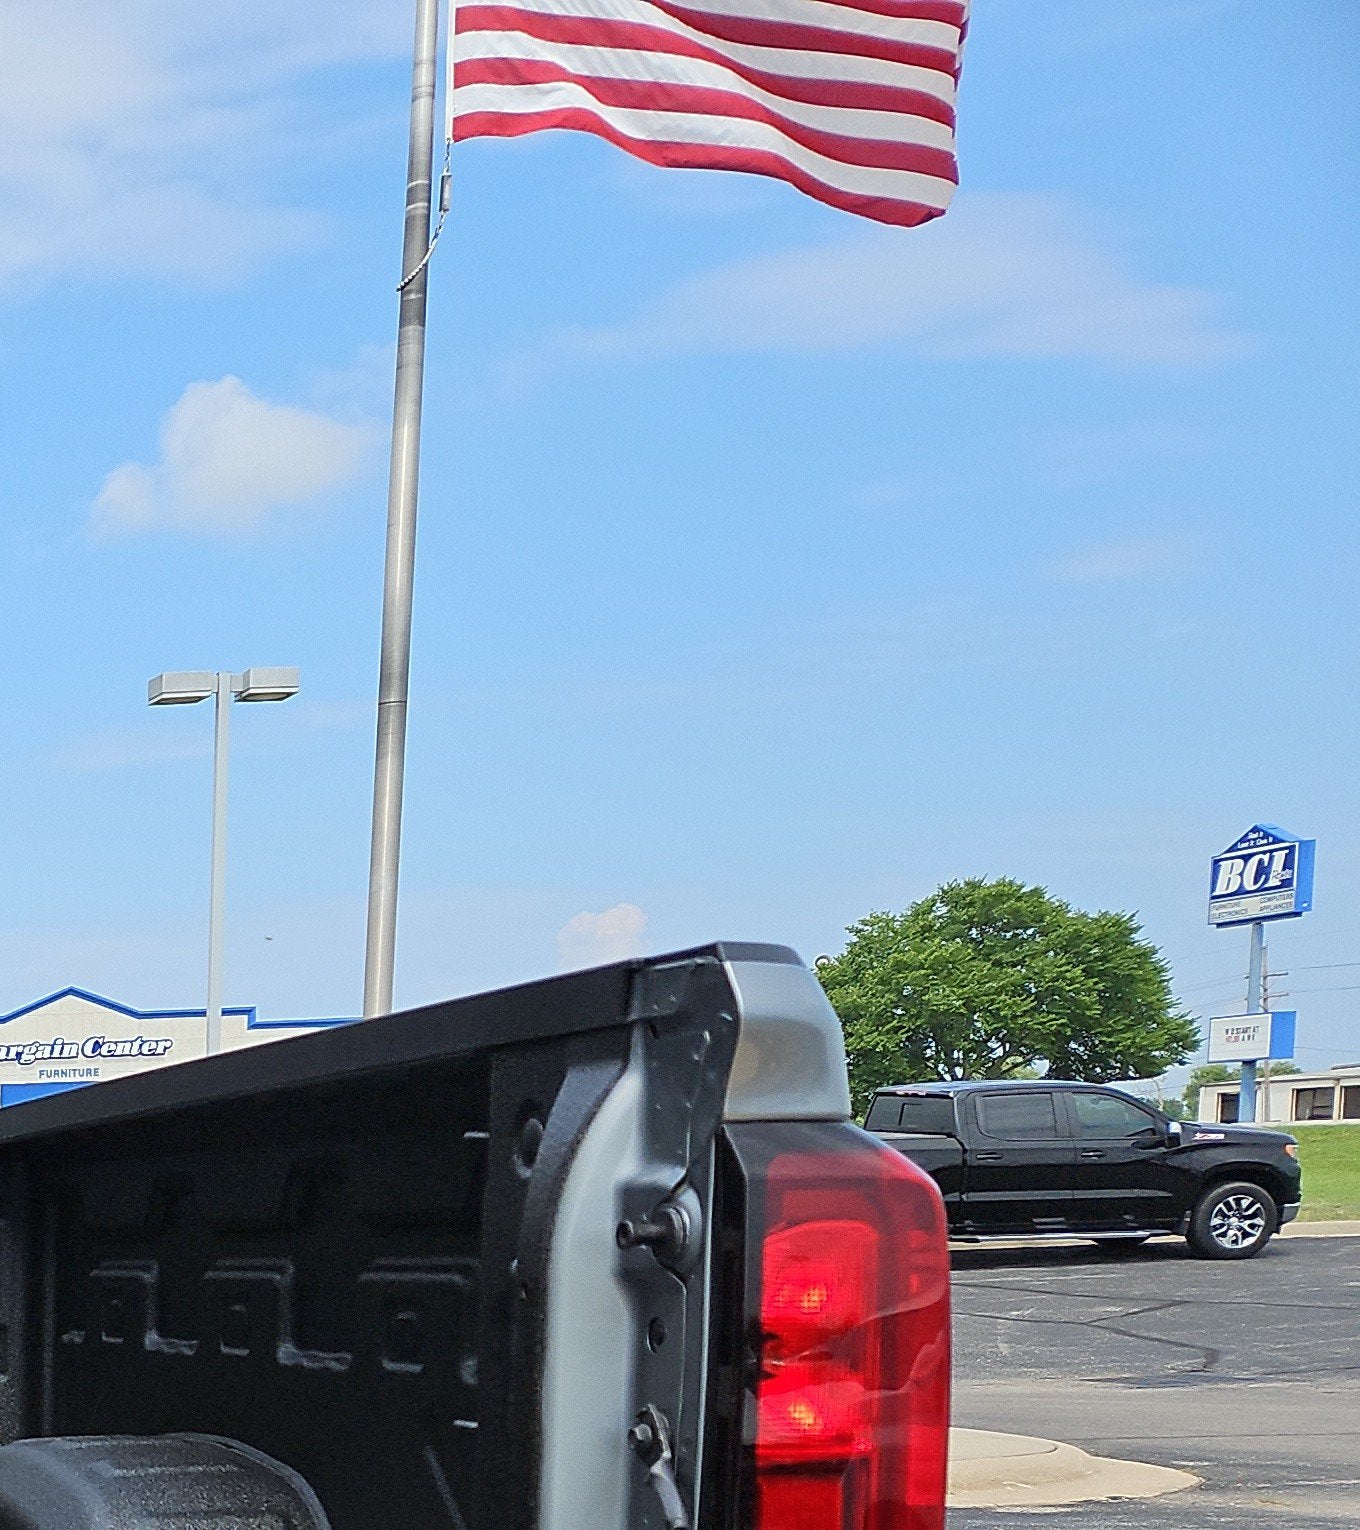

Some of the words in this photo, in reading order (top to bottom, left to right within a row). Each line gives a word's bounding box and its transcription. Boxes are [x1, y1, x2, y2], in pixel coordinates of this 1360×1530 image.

[1211, 849, 1289, 896] BCI
[81, 1035, 173, 1058] Center
[38, 1067, 100, 1080] FURNITURE
